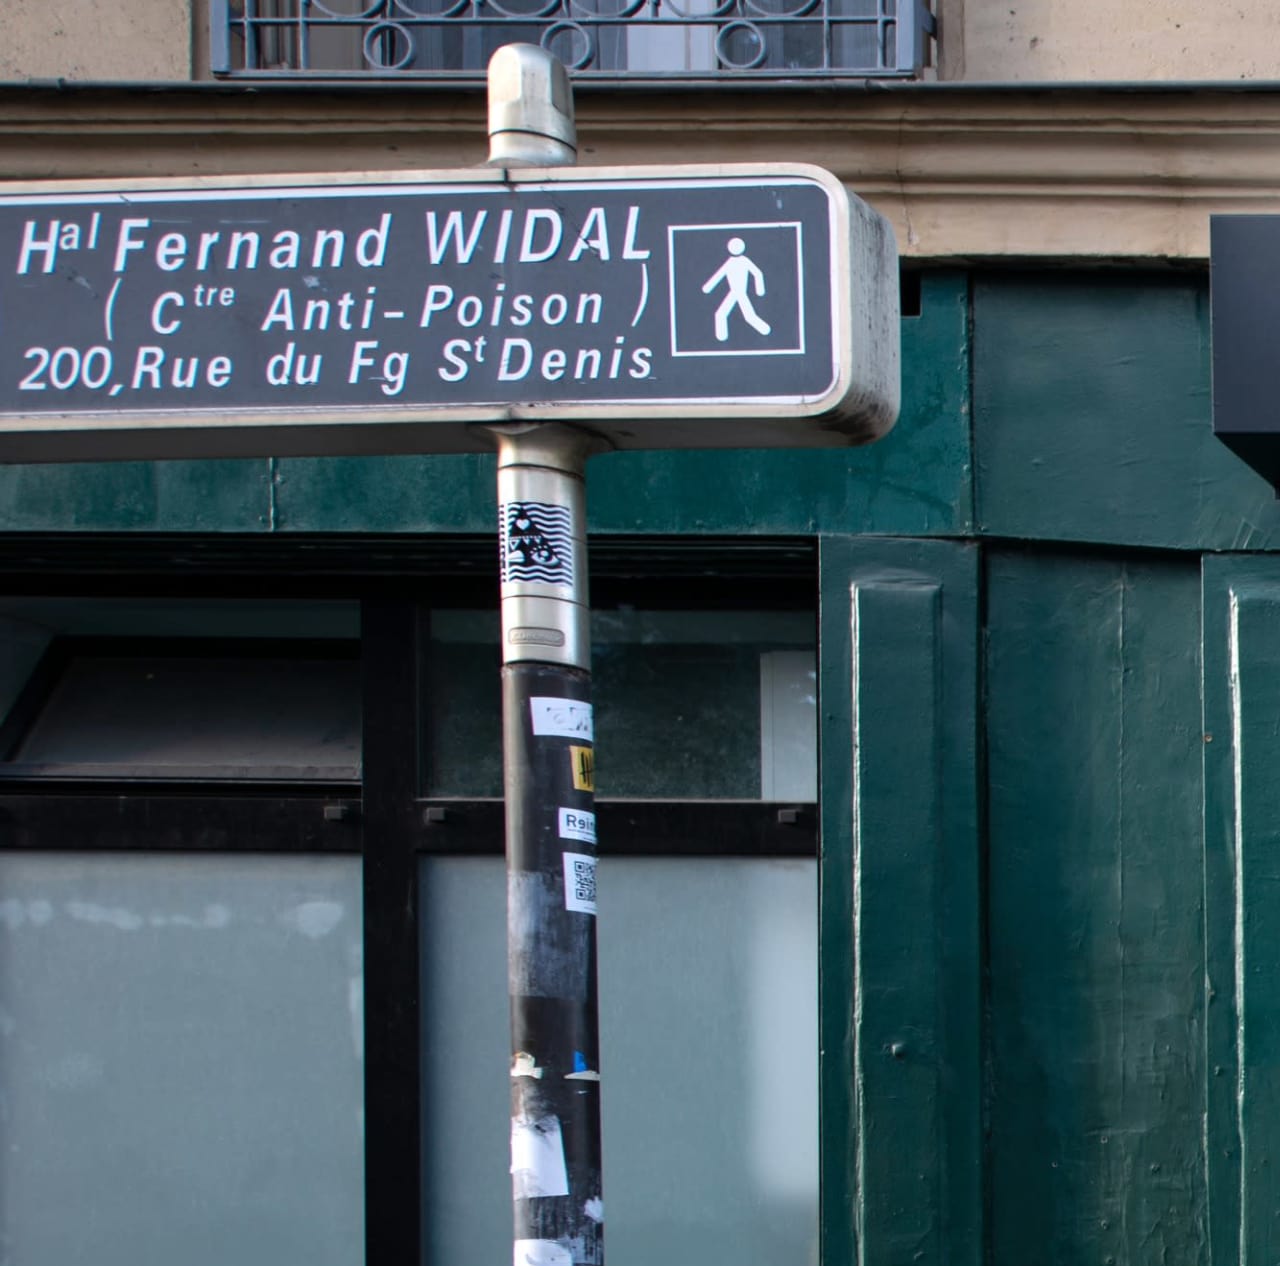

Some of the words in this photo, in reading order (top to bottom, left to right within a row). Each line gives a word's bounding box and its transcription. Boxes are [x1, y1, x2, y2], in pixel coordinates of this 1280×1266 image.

[17, 211, 100, 275] Hal
[114, 212, 392, 272] Fernand
[425, 205, 651, 265] WIDAL
[266, 341, 323, 386] du
[348, 340, 410, 396] Fg
[497, 337, 653, 382] Denis
